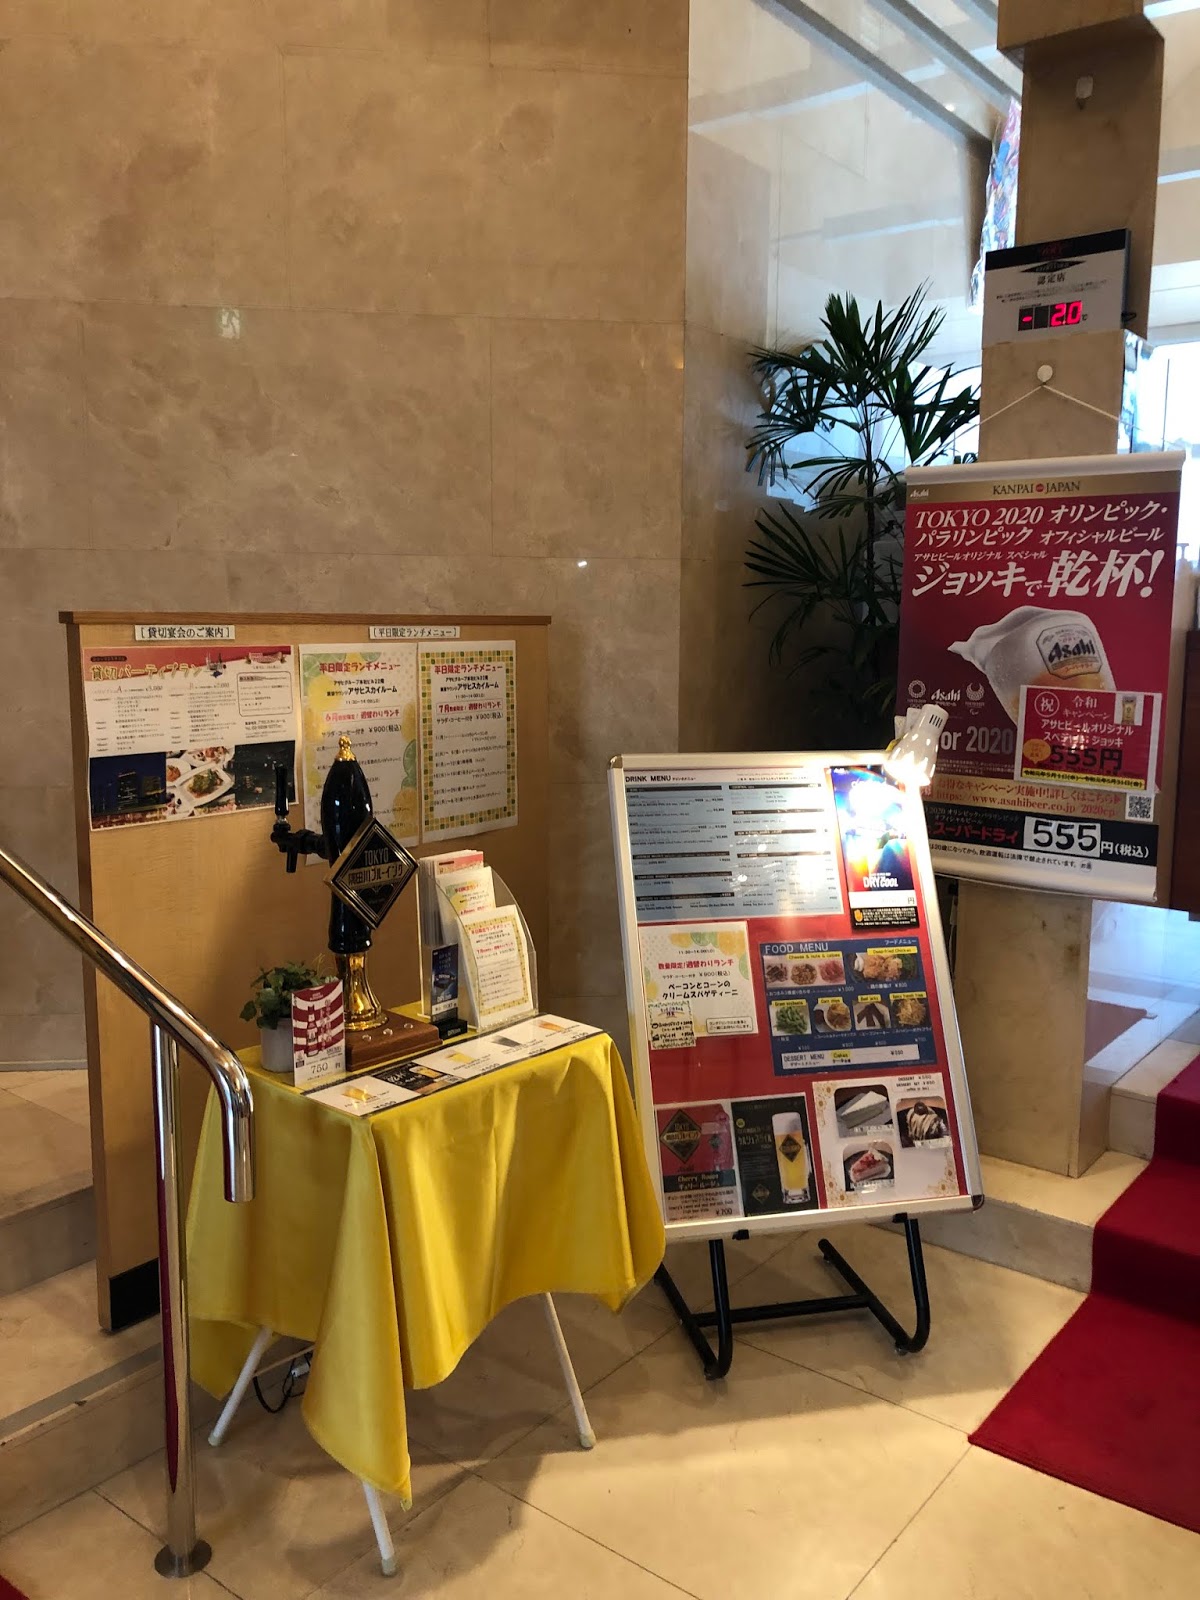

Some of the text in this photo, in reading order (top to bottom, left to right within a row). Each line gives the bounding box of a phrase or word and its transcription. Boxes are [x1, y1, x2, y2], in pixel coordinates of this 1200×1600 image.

[993, 481, 1082, 496] KANPAI JAPAN
[915, 509, 991, 530] TOKYO
[991, 506, 1045, 526] 2020
[914, 525, 1166, 548] パラリンピック オフィシャルビール
[1048, 639, 1096, 664] Asahi
[930, 688, 961, 702] Asahi
[1072, 695, 1098, 709] 令和
[1040, 696, 1055, 712] 祝
[965, 726, 1014, 755] 2020
[1091, 736, 1124, 748] ジョッキ
[1050, 745, 1123, 773] 555円
[625, 775, 647, 783] DRINK
[650, 774, 672, 782] MENU
[1033, 818, 1097, 852] 555
[364, 847, 389, 866] TOKYO
[1101, 841, 1150, 859] 円(税込)
[765, 942, 829, 955] FOOD MENU
[311, 1062, 329, 1074] 750
